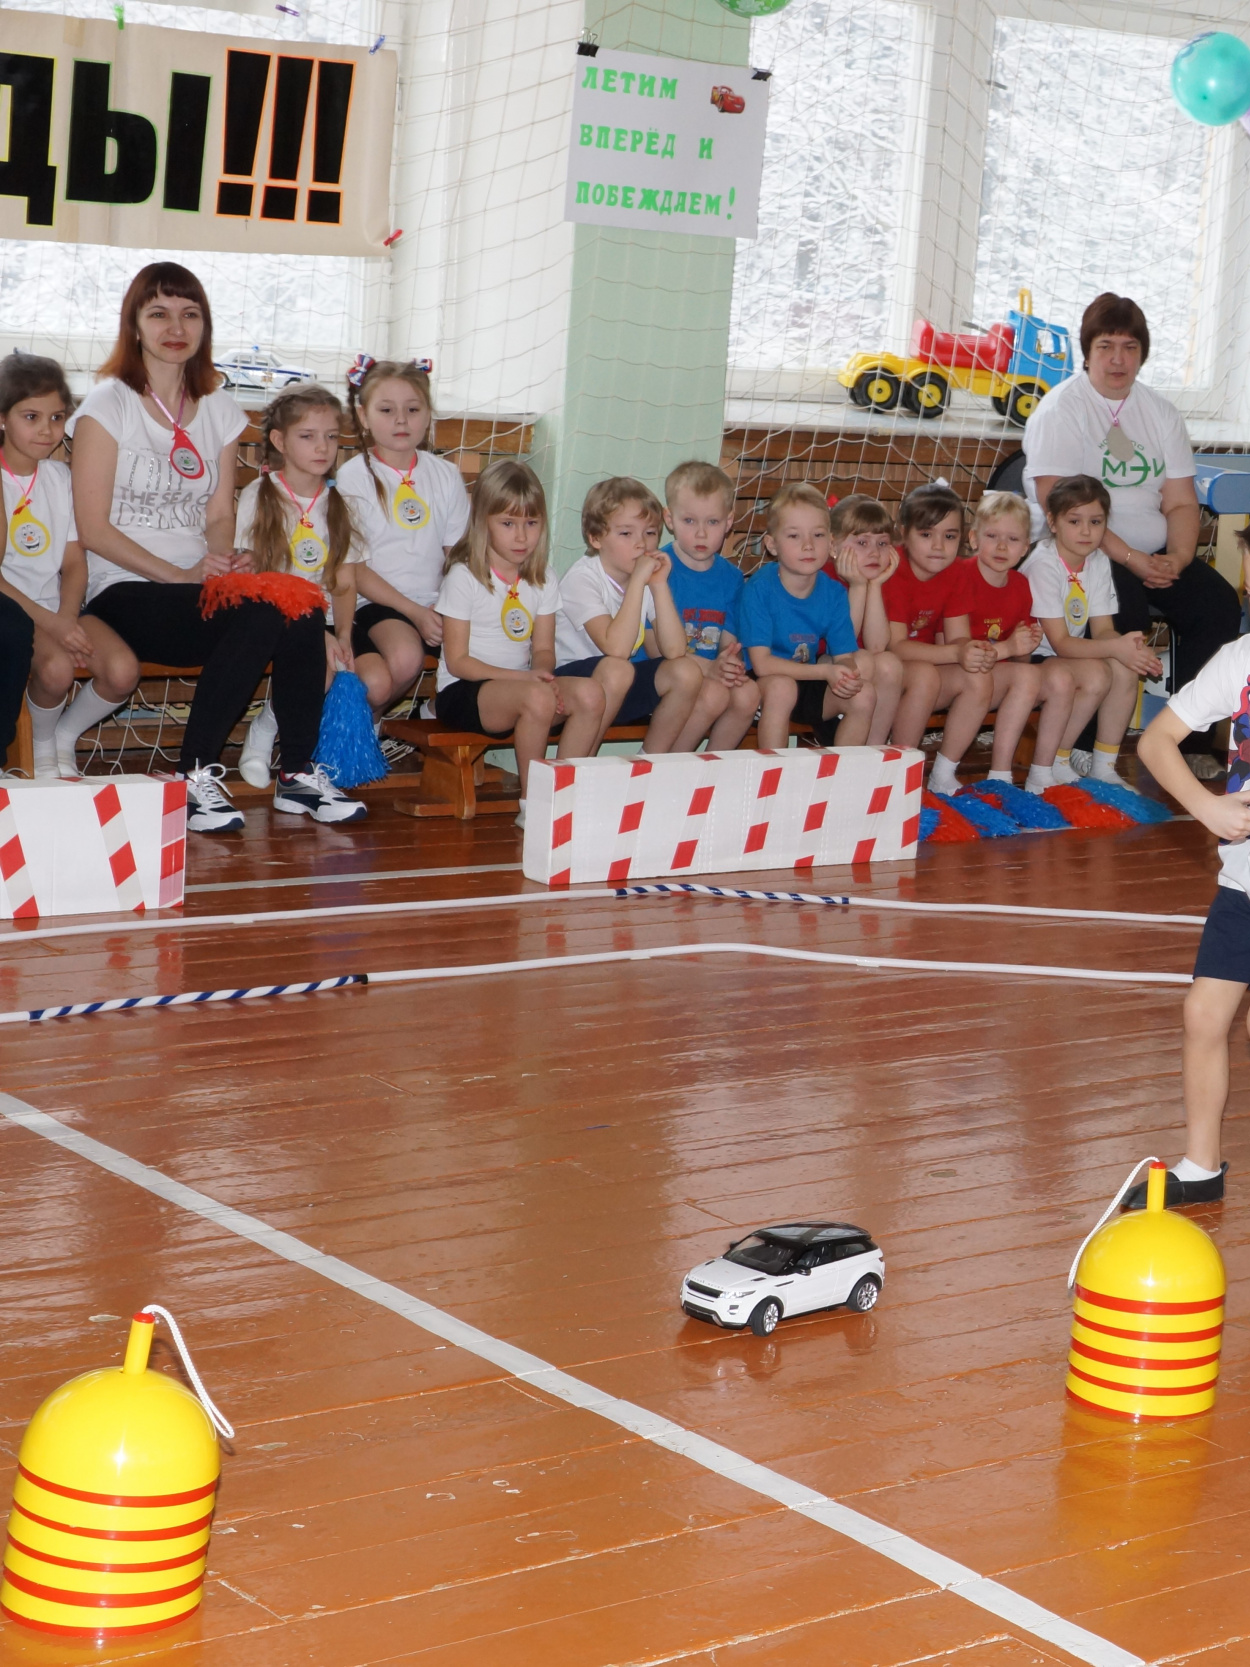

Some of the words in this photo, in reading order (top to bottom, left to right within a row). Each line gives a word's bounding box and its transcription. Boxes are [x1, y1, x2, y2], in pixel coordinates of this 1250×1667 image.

[581, 66, 678, 100] ЛЕТИМ
[579, 123, 676, 159] ВПЕРЁД
[698, 137, 714, 159] И
[575, 181, 736, 220] ПОБЕЖДАЕМ!
[120, 486, 159, 506] THE
[160, 491, 193, 506] SEA
